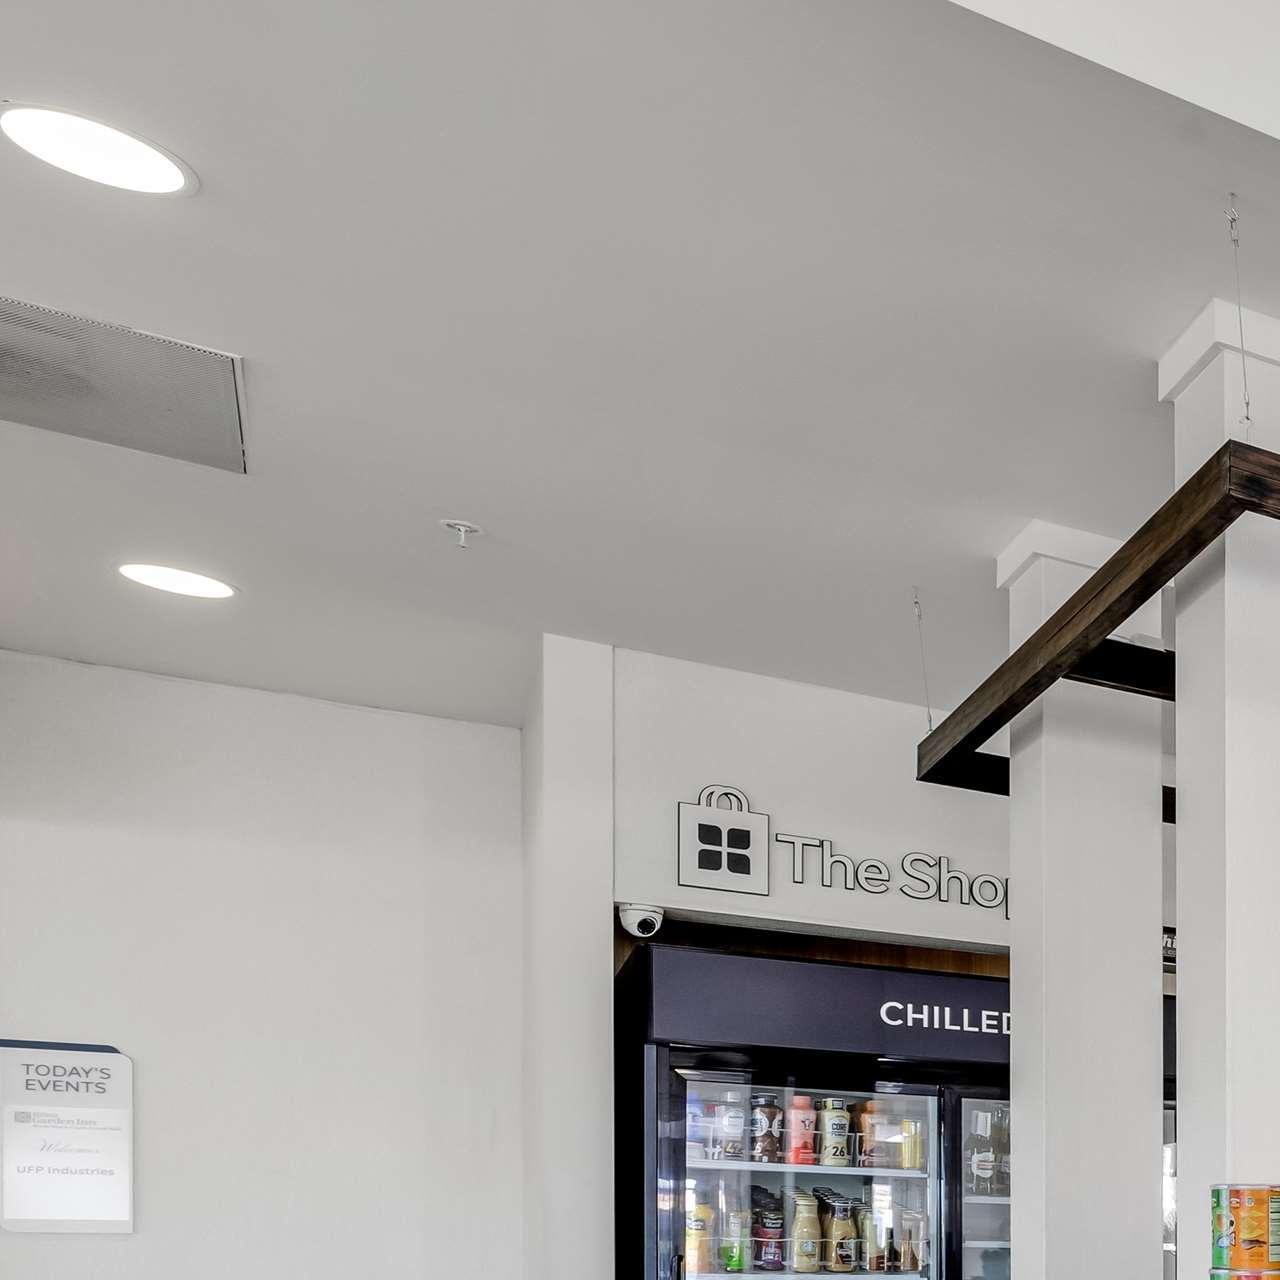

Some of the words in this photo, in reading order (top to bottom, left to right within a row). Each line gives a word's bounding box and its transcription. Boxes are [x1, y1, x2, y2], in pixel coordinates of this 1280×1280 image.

[776, 832, 890, 894] The
[900, 852, 1010, 920] Sho
[21, 1063, 111, 1080] TODAY'S
[25, 1078, 107, 1094] EVENTS
[832, 1145, 846, 1157] 26
